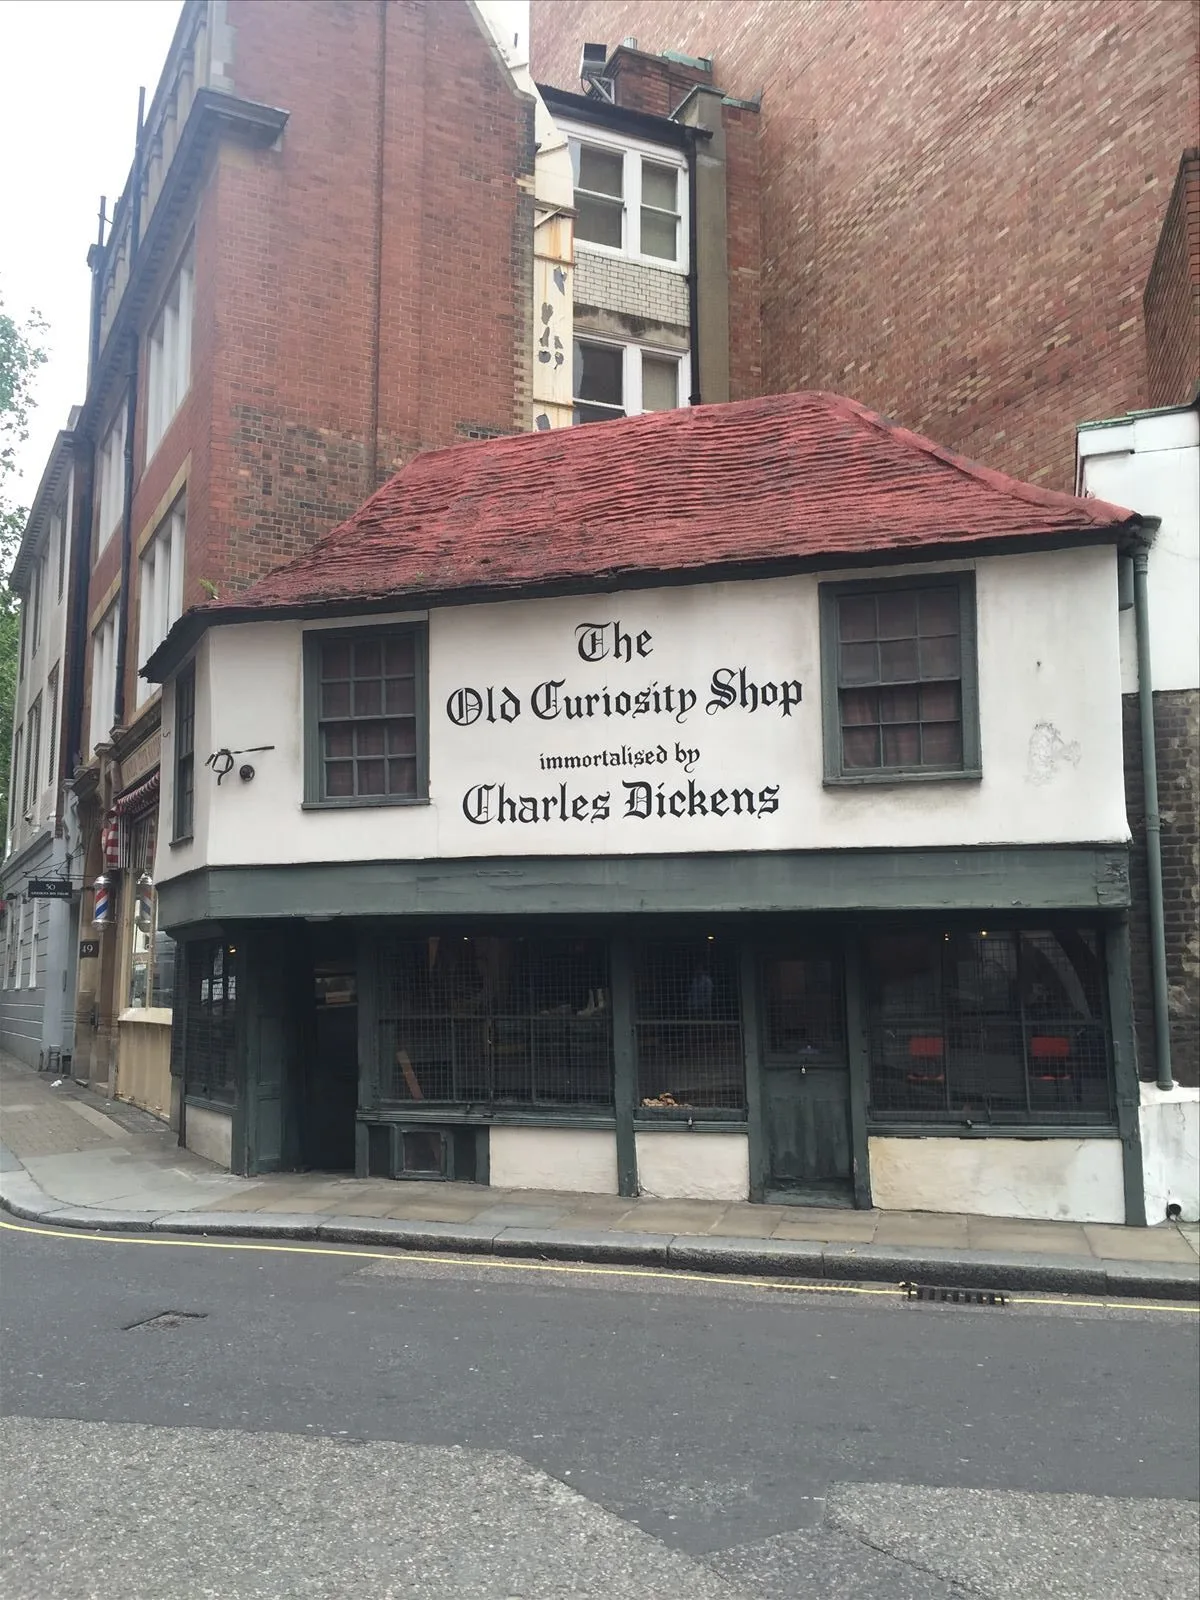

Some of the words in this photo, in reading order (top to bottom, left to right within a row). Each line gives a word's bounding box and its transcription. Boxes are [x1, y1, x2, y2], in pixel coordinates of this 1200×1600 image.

[575, 621, 654, 664] The
[446, 686, 521, 727] Old
[531, 679, 697, 724] Curiosity
[706, 666, 802, 717] Shop
[539, 745, 668, 771] immortalised
[675, 743, 701, 773] by
[462, 783, 612, 825] Charles
[621, 779, 780, 821] Dickens
